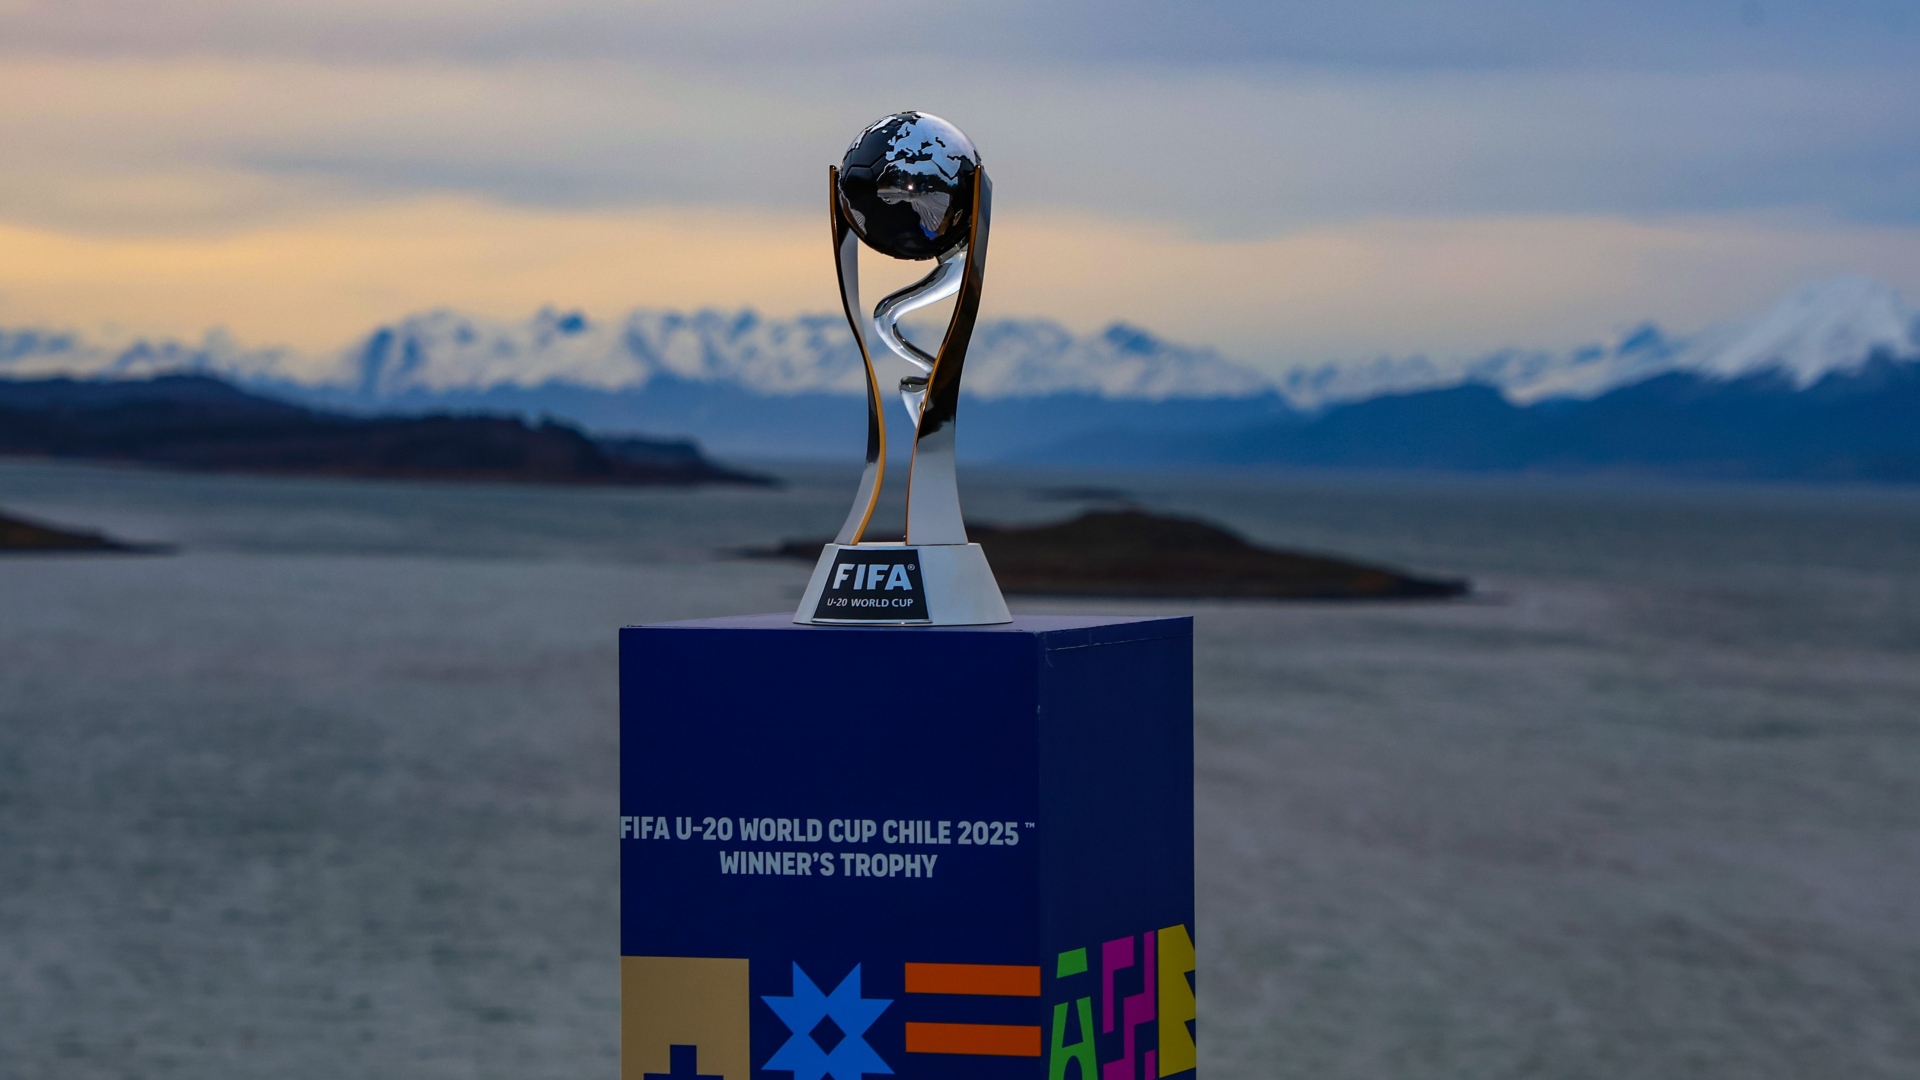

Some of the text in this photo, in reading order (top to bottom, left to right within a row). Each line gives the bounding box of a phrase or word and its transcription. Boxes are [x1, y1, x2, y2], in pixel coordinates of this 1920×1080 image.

[827, 597, 914, 608] U-20 WORLD CUP
[620, 816, 670, 840] FIFA
[676, 816, 733, 841] U-20
[739, 817, 823, 842] WORLD
[828, 818, 877, 843] CUP
[882, 819, 951, 845] CHILE
[719, 851, 938, 878] WINNER’S TROPHY
